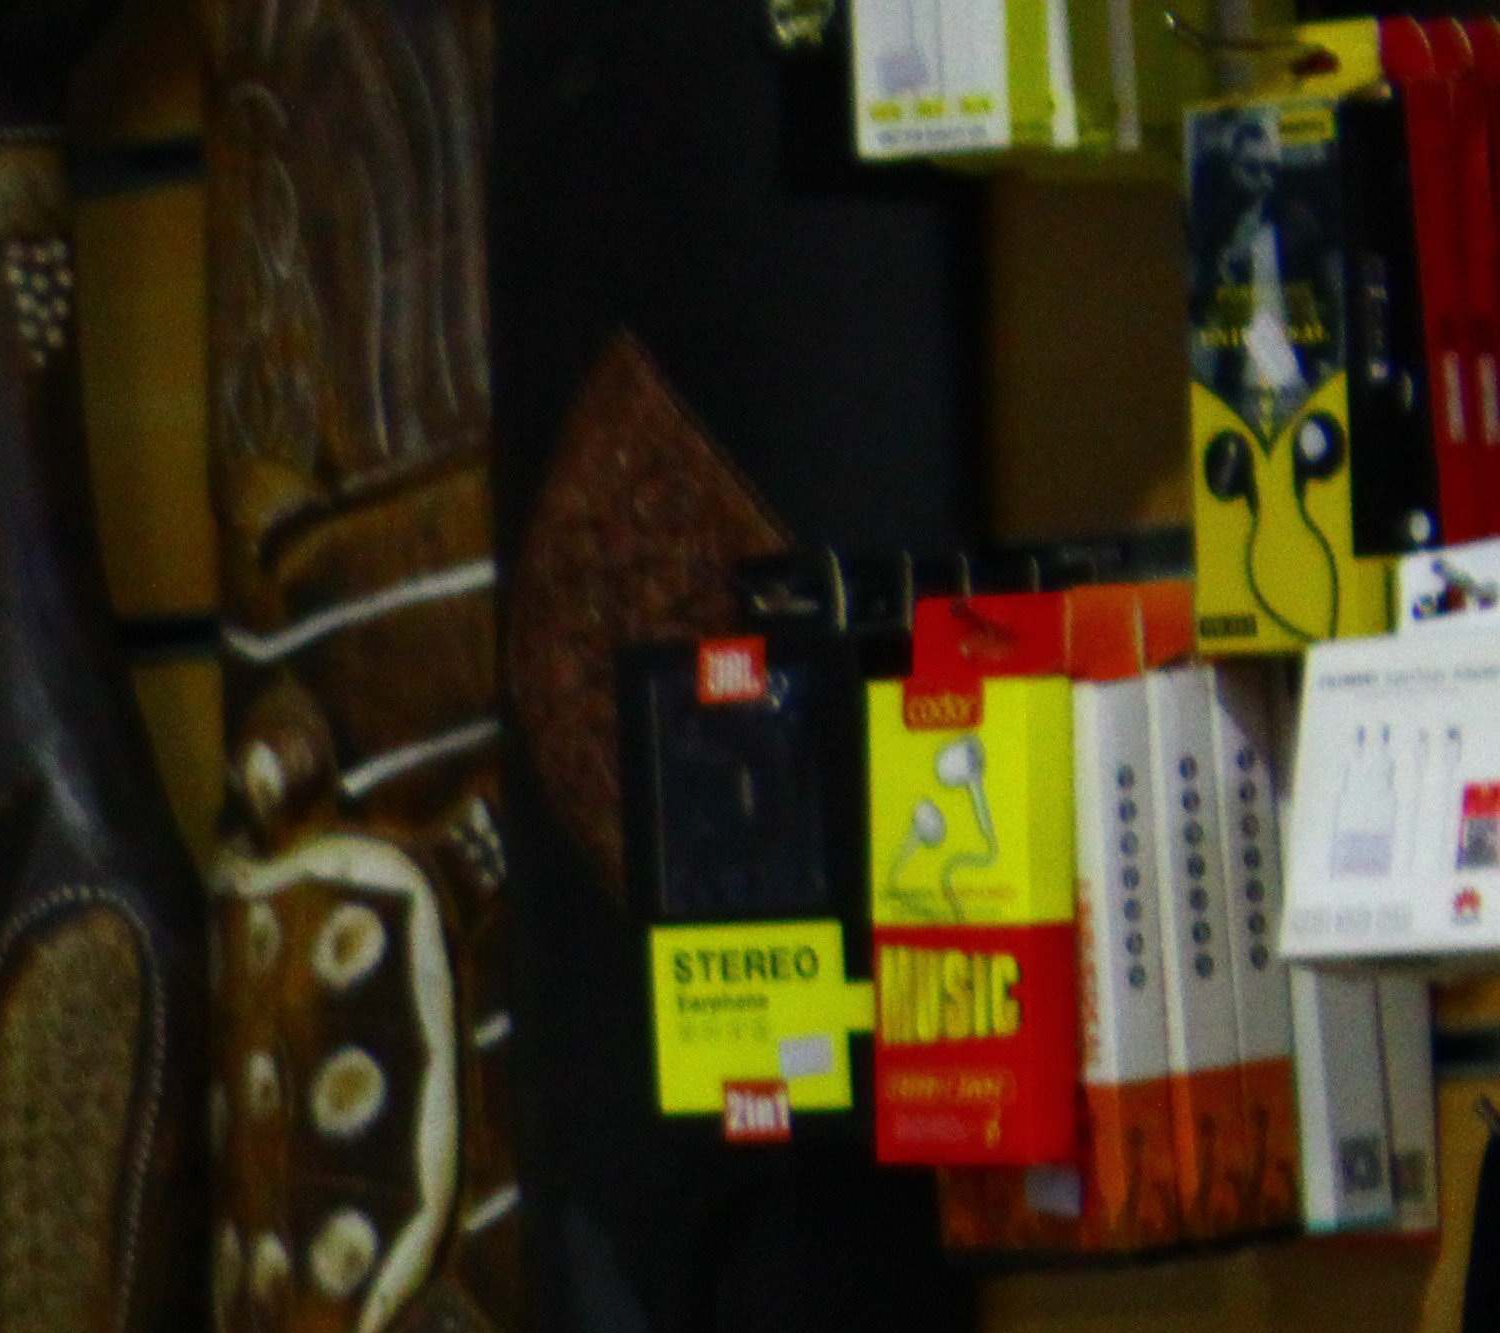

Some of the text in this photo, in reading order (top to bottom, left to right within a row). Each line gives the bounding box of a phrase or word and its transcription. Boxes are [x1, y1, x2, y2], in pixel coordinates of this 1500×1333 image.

[706, 652, 763, 695] JBL
[673, 946, 819, 985] STEREO
[879, 945, 1021, 1044] MUSIC
